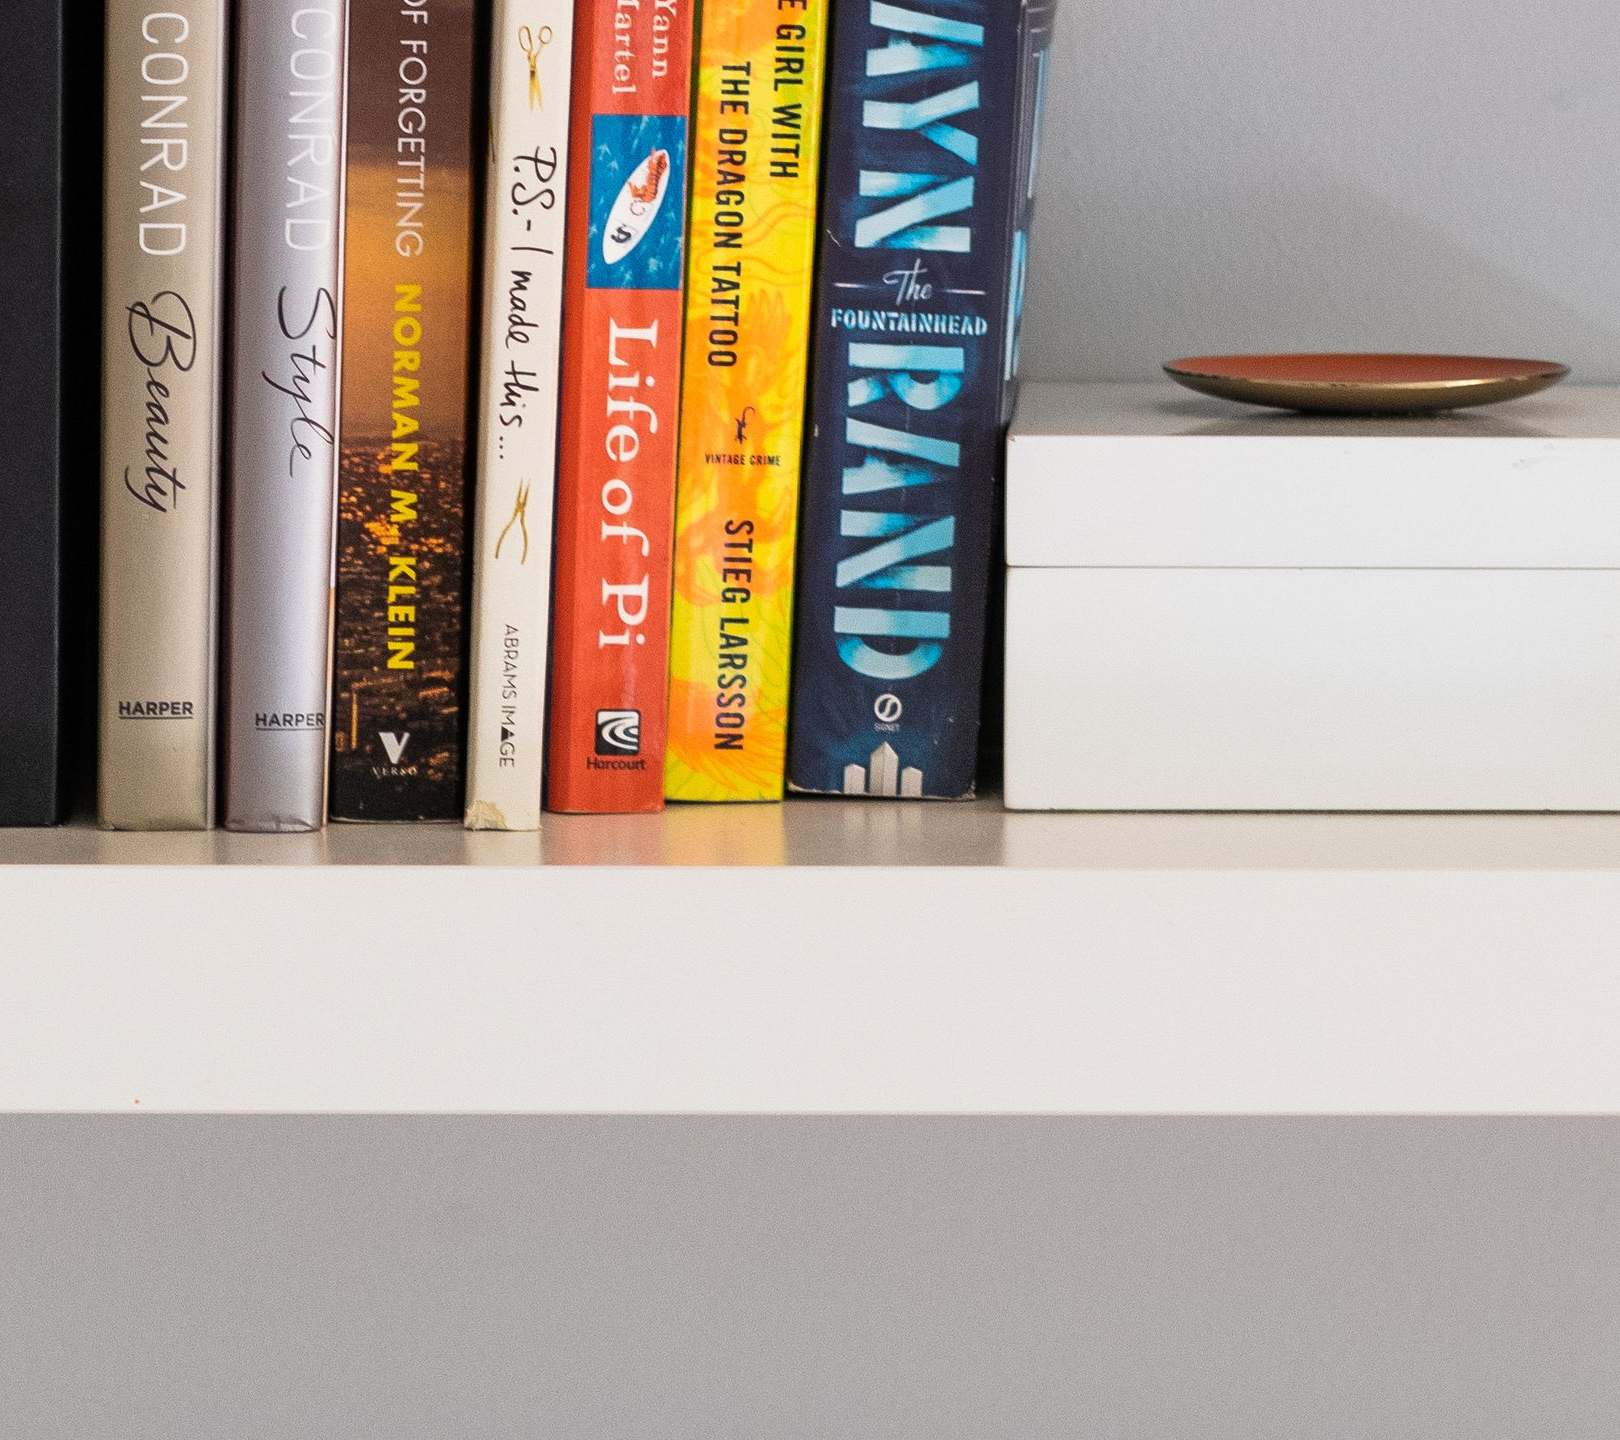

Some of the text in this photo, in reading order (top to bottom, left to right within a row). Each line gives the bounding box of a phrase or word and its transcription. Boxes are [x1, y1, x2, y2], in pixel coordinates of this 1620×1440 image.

[139, 13, 189, 256] CONRAD
[285, 7, 335, 251] CONRAD
[769, 101, 802, 178] WITH
[773, 25, 806, 91] GIRL
[854, 0, 984, 253] AYN
[395, 40, 428, 257] FORGETTING
[707, 60, 751, 367] THE DRAGON TATTOO
[505, 270, 539, 349] made
[511, 246, 554, 255] I
[830, 308, 987, 336] FOUNTAINHEAD
[882, 257, 933, 305] The
[124, 290, 196, 513] Beauty
[263, 285, 337, 479] Style
[705, 453, 781, 466] VINTAGE CRIME
[387, 284, 423, 670] NORMAN M. KLEIN
[598, 317, 658, 650] Life of Pi
[834, 342, 965, 680] RAND
[119, 701, 193, 715] HARPER
[255, 713, 324, 726] HARPER
[498, 623, 519, 768] ABRAMS IMAGE
[714, 520, 754, 751] STIEG LARSSON
[586, 757, 646, 771] Harcourt
